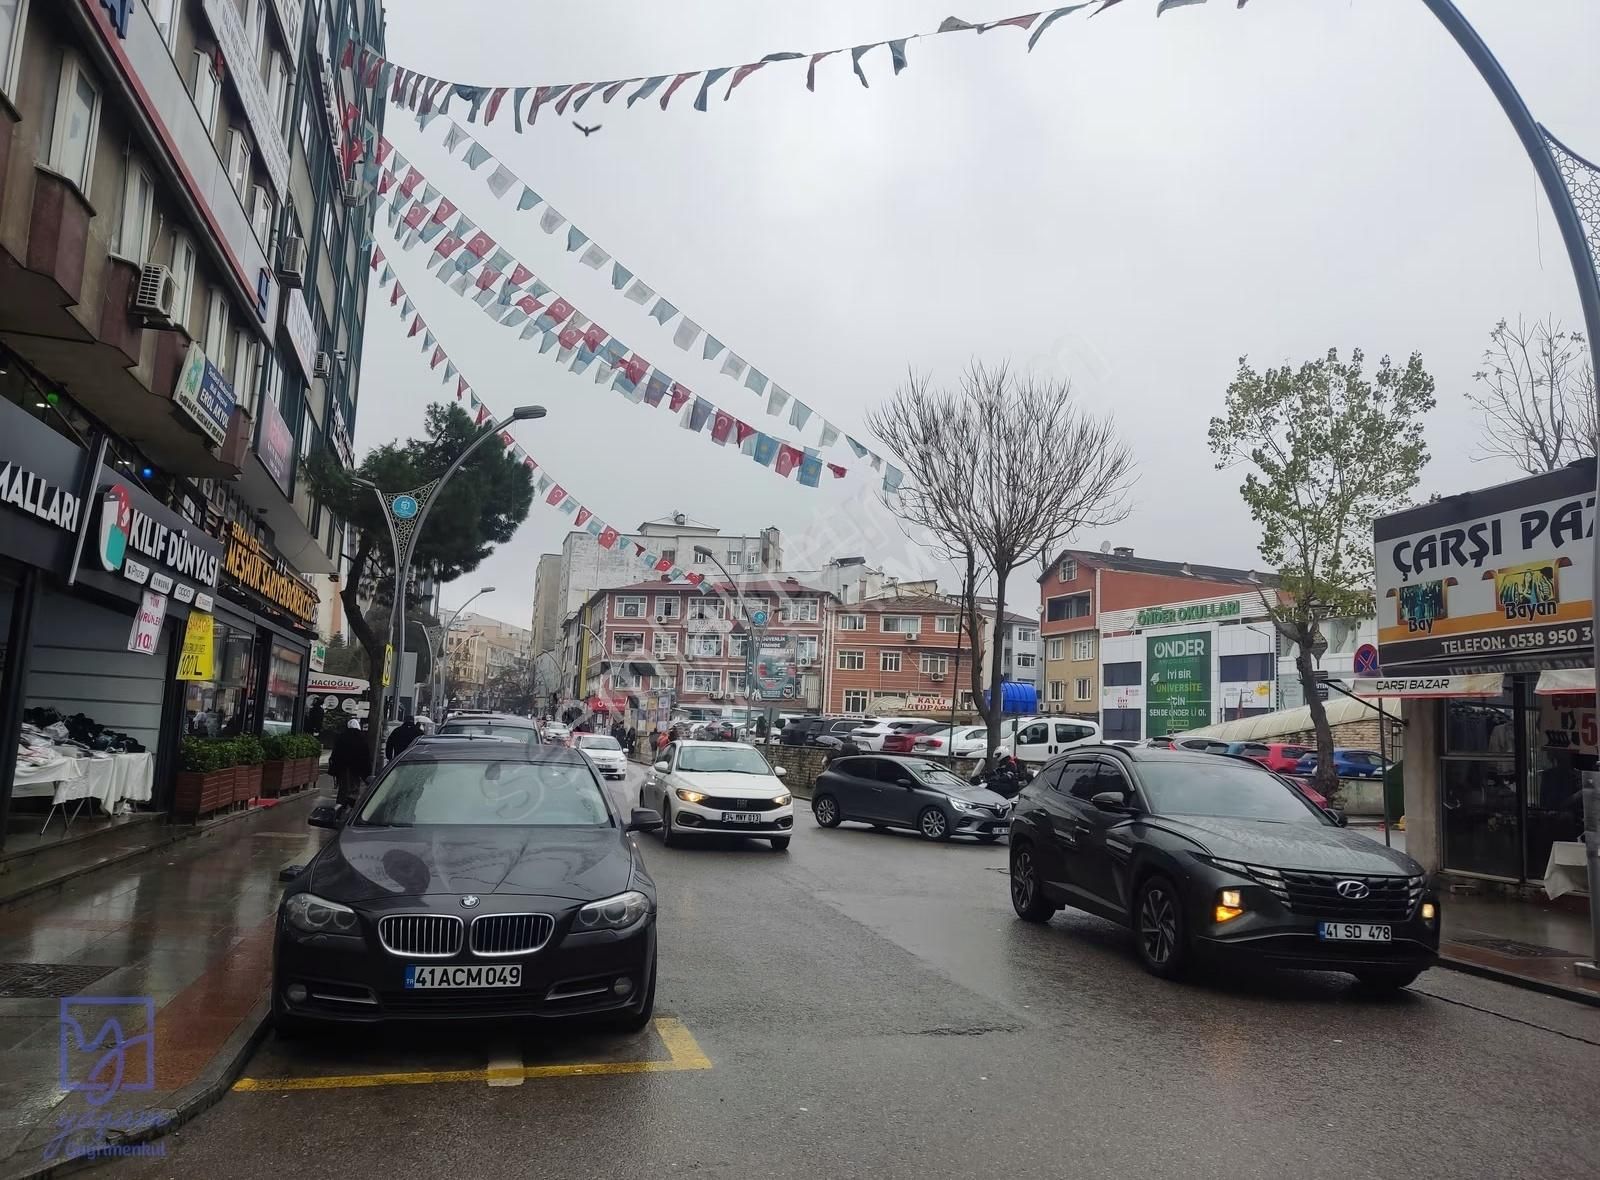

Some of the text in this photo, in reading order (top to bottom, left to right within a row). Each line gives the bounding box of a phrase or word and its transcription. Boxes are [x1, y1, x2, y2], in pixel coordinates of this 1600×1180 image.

[200, 388, 213, 412] EROL
[212, 403, 230, 428] AKYOL
[129, 509, 219, 588] KILIF DÜNYASI
[1393, 518, 1502, 582] ÇARŞI
[225, 538, 262, 591] MEŞHUR
[1138, 600, 1240, 625] ÖNDER OKULLARI
[1505, 601, 1558, 621] Bayan
[1408, 616, 1434, 633] Bay
[1441, 636, 1505, 654] TELEFON:
[1509, 632, 1544, 648] 0538
[1546, 629, 1577, 644] 950
[311, 679, 354, 687] HACIOĞLU
[1178, 668, 1191, 679] BİR
[1409, 678, 1450, 690] BAZAR
[1325, 923, 1391, 940] 41 SD 478
